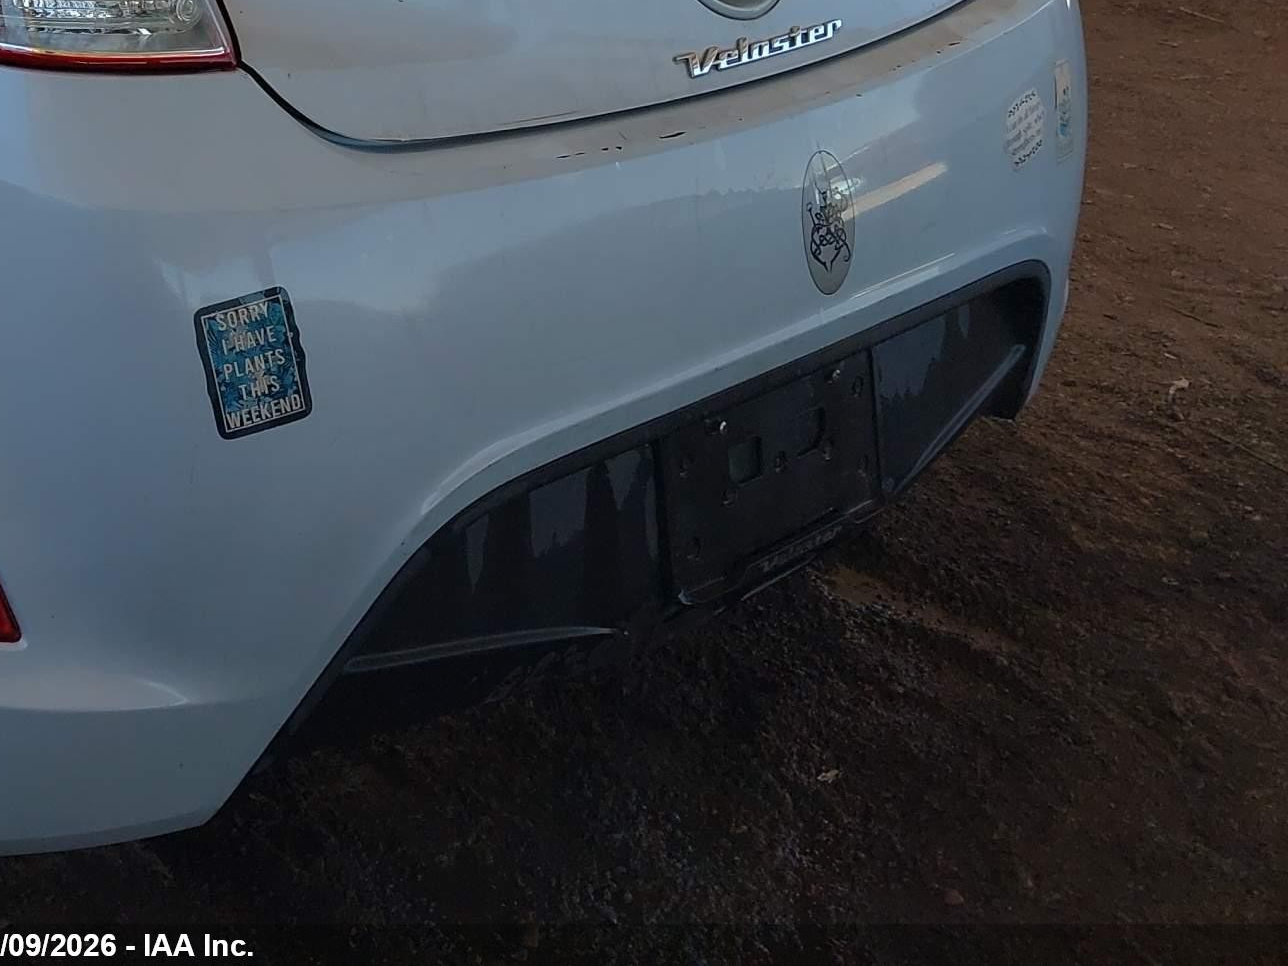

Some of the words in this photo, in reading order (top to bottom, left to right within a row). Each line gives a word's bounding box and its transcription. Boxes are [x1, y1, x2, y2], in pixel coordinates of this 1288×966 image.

[673, 18, 843, 78] Veloster
[215, 301, 270, 332] SORRY
[221, 338, 228, 355] I
[233, 325, 277, 352] HAVE
[223, 348, 286, 381] PLANTS
[238, 375, 281, 400] THIS
[225, 393, 302, 429] WEEKEND
